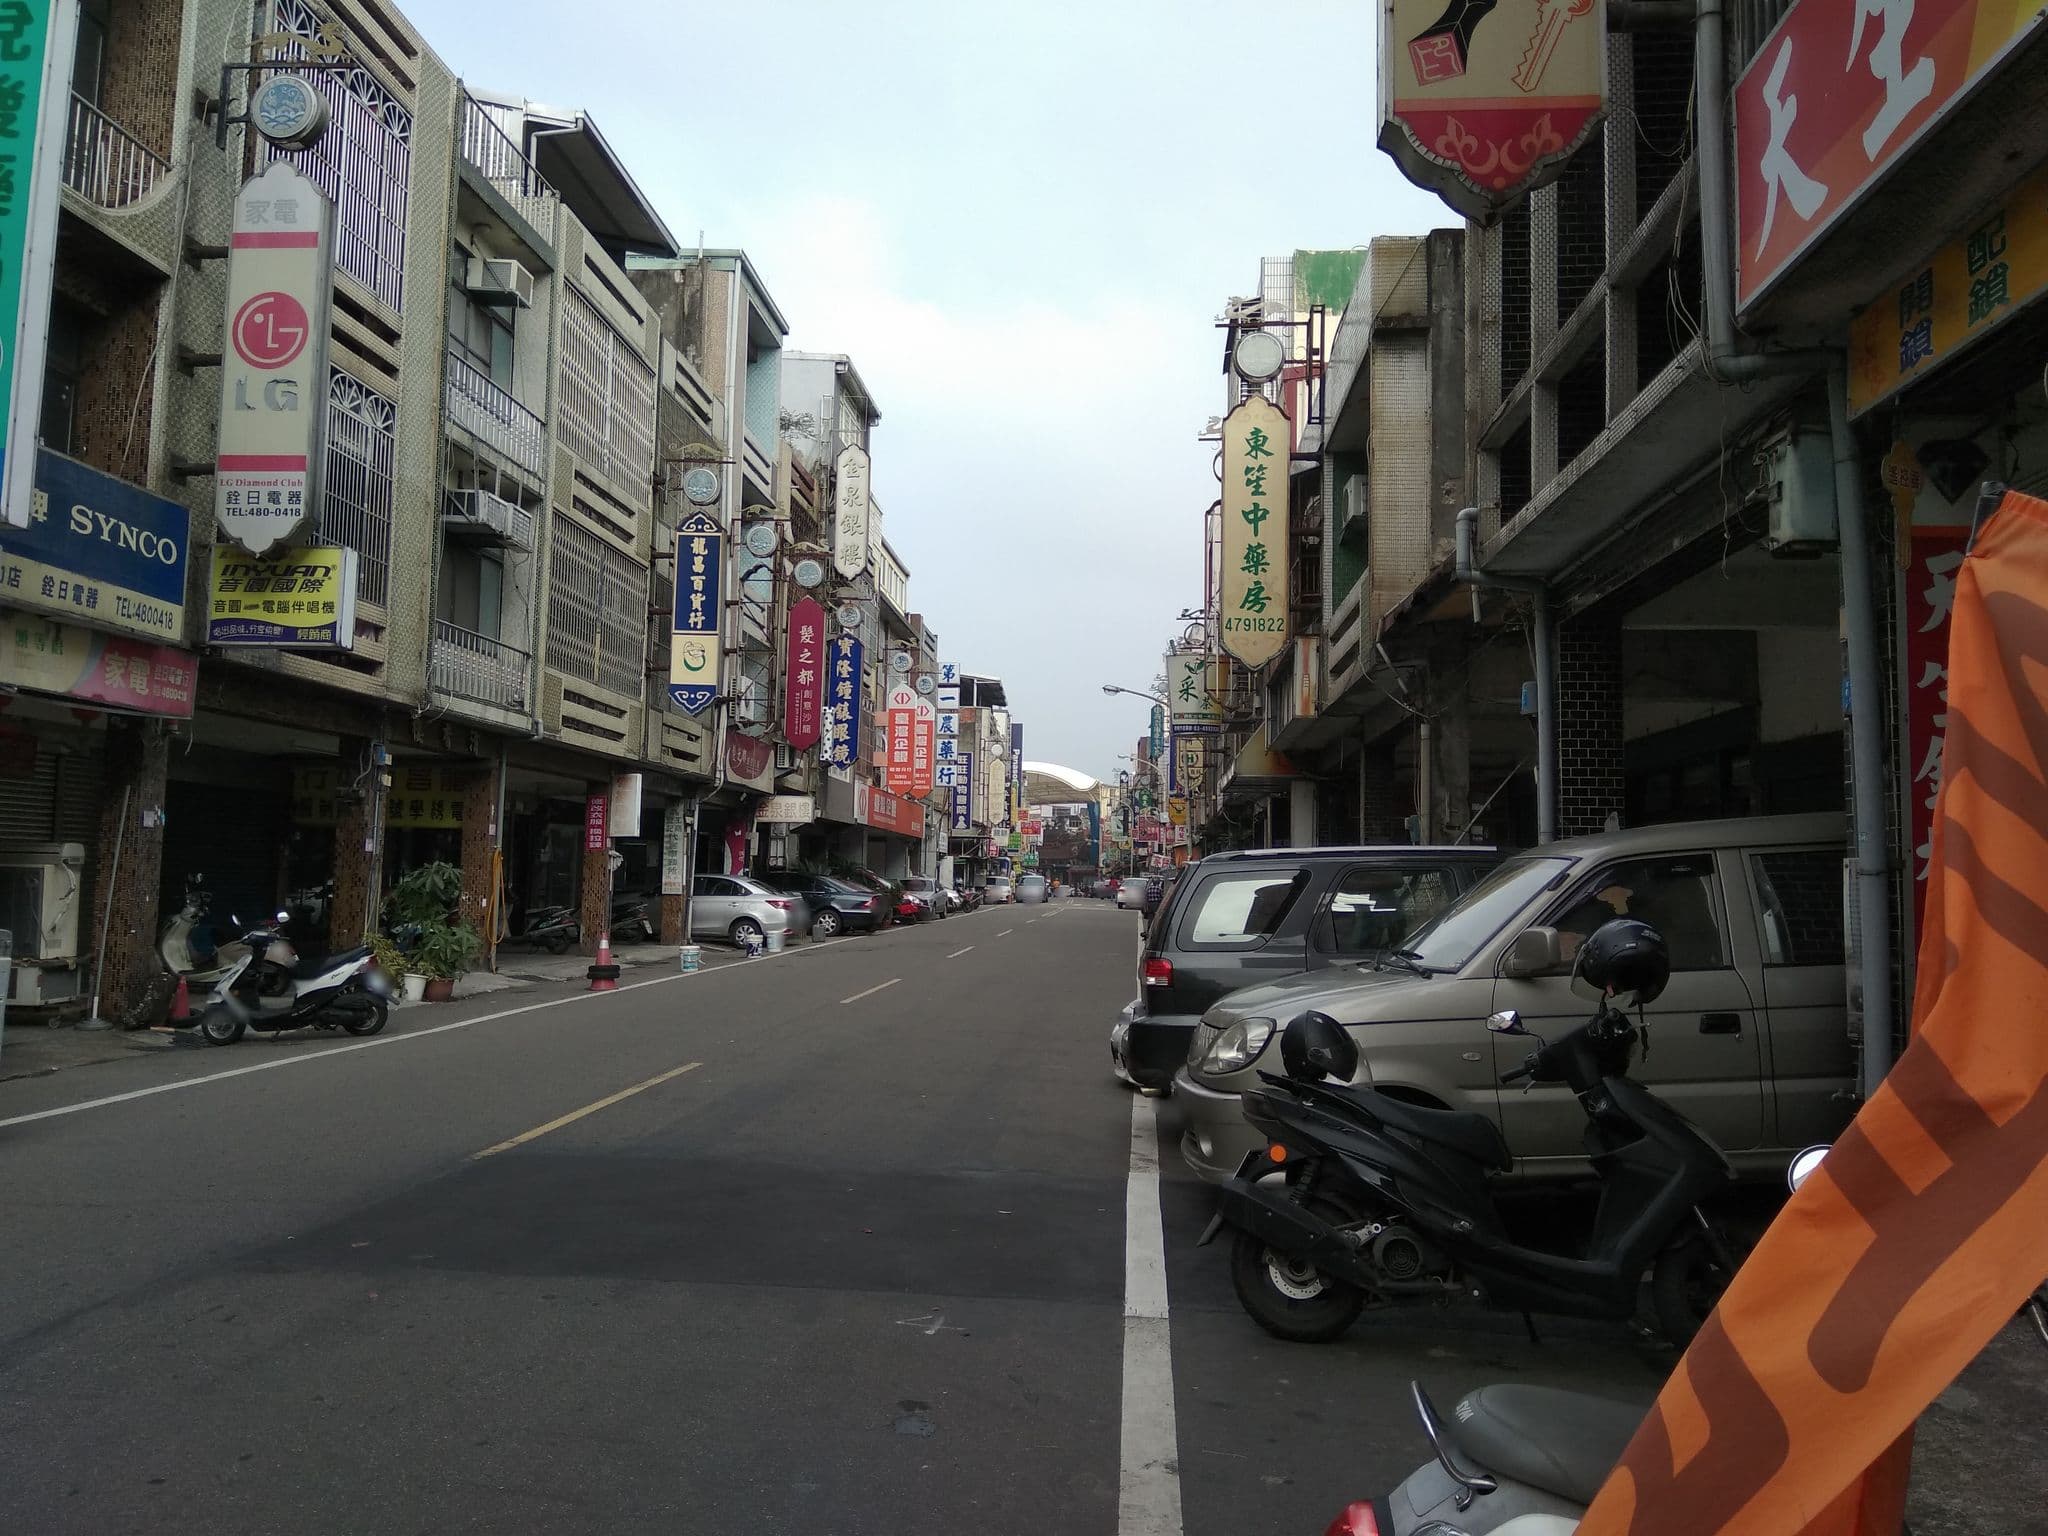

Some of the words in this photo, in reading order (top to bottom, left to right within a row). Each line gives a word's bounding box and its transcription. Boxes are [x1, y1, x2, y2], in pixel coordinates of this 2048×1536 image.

[244, 199, 299, 225] 家電
[235, 375, 299, 411] LG
[220, 479, 233, 487] LG
[235, 478, 279, 487] Diamond
[281, 479, 303, 487] Club
[226, 490, 302, 505] 銓日電器
[226, 508, 301, 517] TEL:480-0418
[839, 458, 866, 568] 金泉銀樓
[1239, 426, 1275, 615] 東笙中藥房
[70, 504, 178, 565] SYNCO
[217, 578, 326, 594] 音圓國際
[688, 536, 708, 629] 龍昌百貨行
[41, 575, 99, 609] 銓日電器
[116, 595, 174, 630] TEL:4800418
[1225, 617, 1285, 632] 4791822
[796, 625, 815, 687] 髮之都
[104, 653, 151, 696] 家電
[1178, 675, 1199, 703] 采
[1200, 695, 1214, 710] 茶
[937, 664, 957, 785] 第一農藥行
[756, 801, 812, 822] 金泉銀樓
